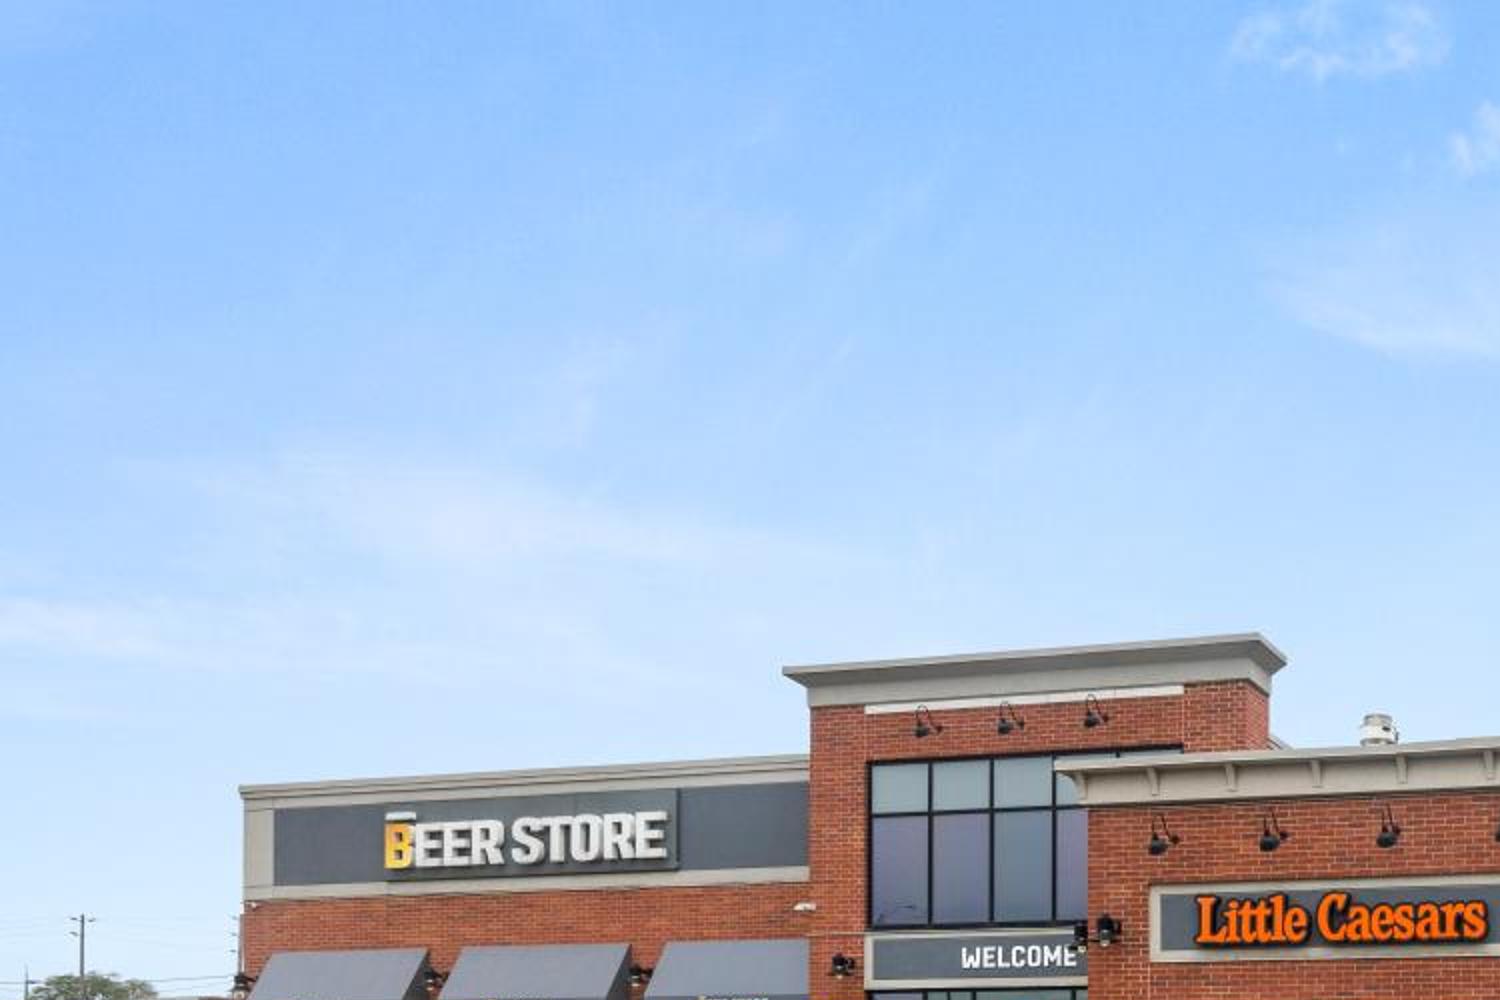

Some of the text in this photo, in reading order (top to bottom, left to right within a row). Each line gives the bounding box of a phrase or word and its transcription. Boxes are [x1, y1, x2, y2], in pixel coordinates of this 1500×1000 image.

[384, 811, 668, 869] BEER STORE
[1195, 891, 1488, 943] Little Caesars
[961, 945, 1077, 968] WELCOME
